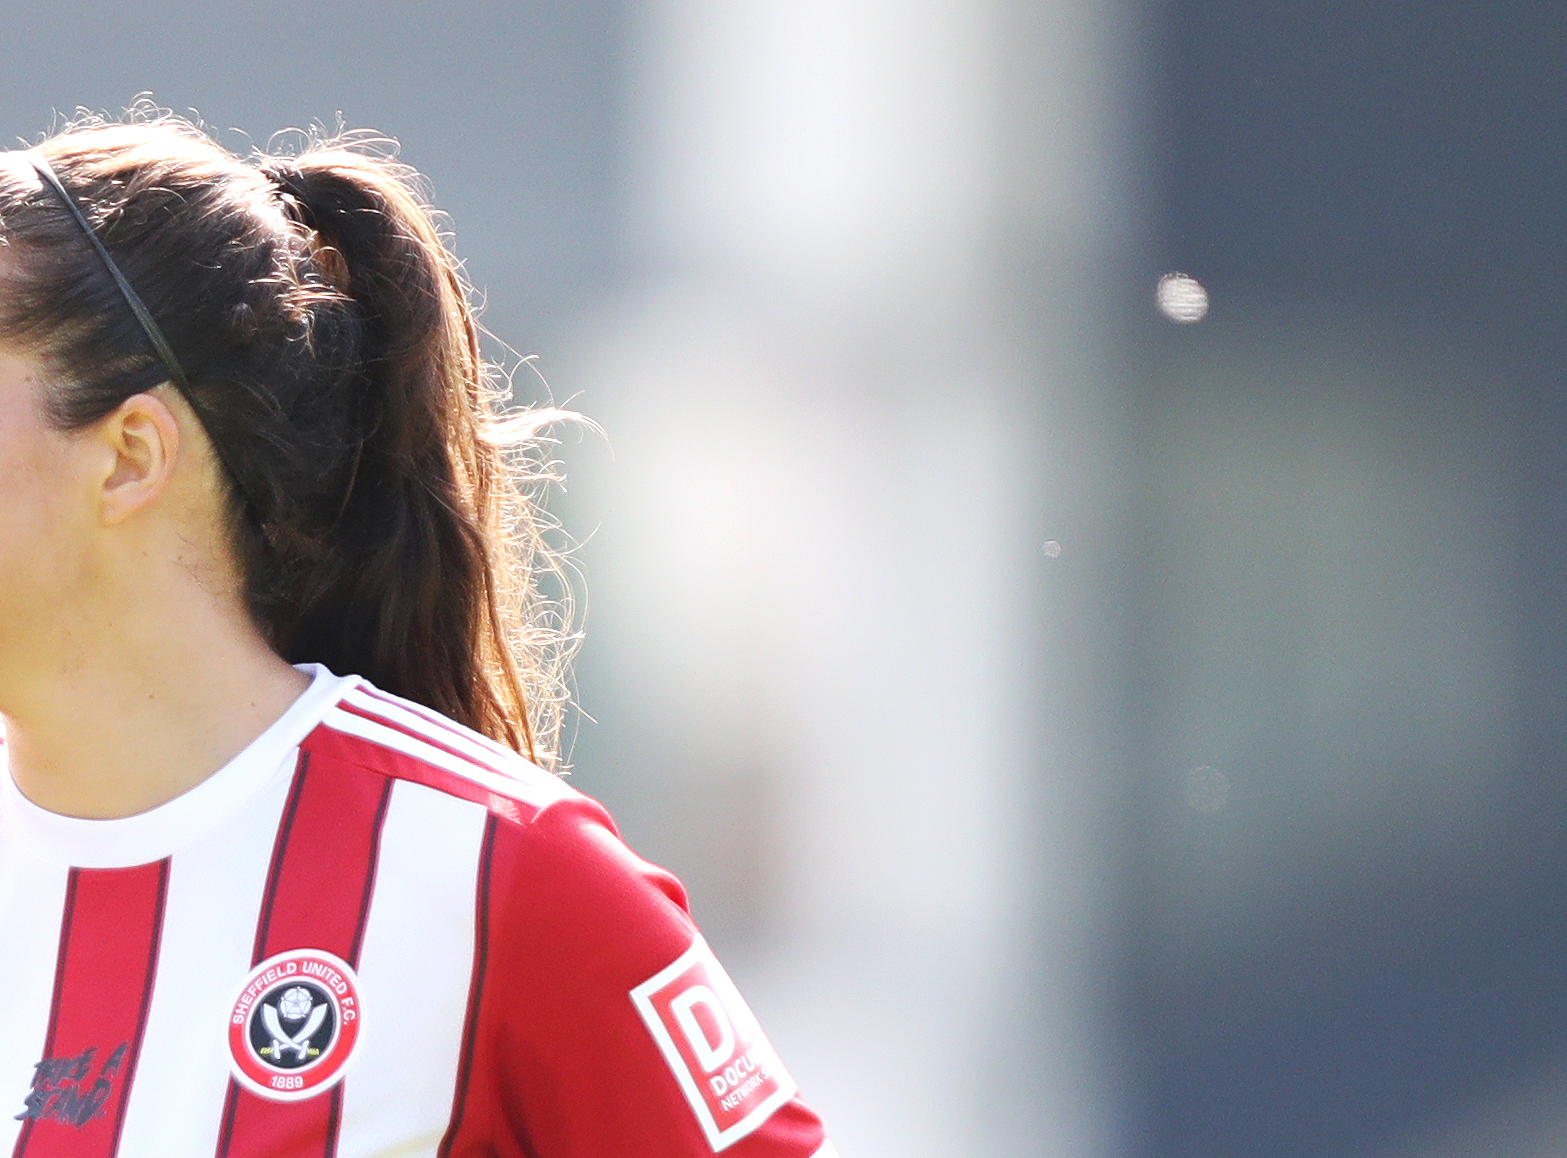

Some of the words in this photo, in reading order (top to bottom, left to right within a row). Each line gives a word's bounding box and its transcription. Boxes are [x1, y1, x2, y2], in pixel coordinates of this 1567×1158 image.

[233, 962, 297, 1025] SHEFFIELD
[301, 961, 348, 995] UNITED
[341, 996, 356, 1025] F.C.
[270, 1075, 304, 1089] 1889
[720, 1071, 764, 1112] NETWORK
